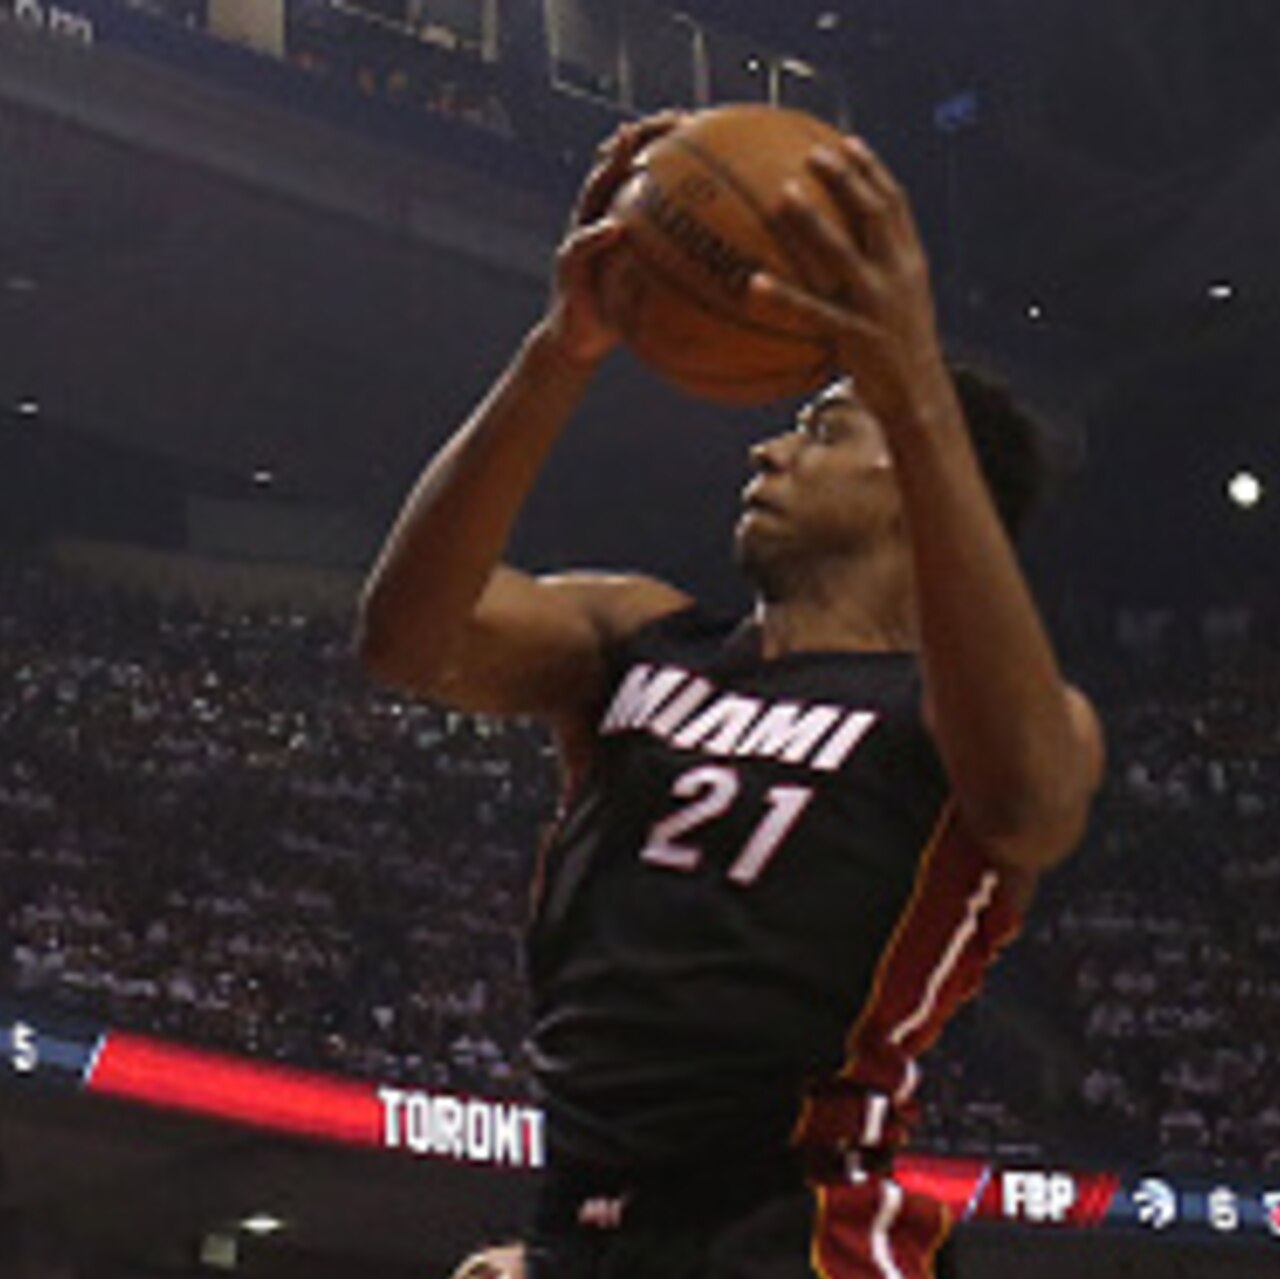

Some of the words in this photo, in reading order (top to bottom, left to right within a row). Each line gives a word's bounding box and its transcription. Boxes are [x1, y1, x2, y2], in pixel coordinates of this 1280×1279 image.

[600, 664, 877, 771] MIAMI
[640, 764, 813, 884] 21
[12, 1022, 37, 1071] 5
